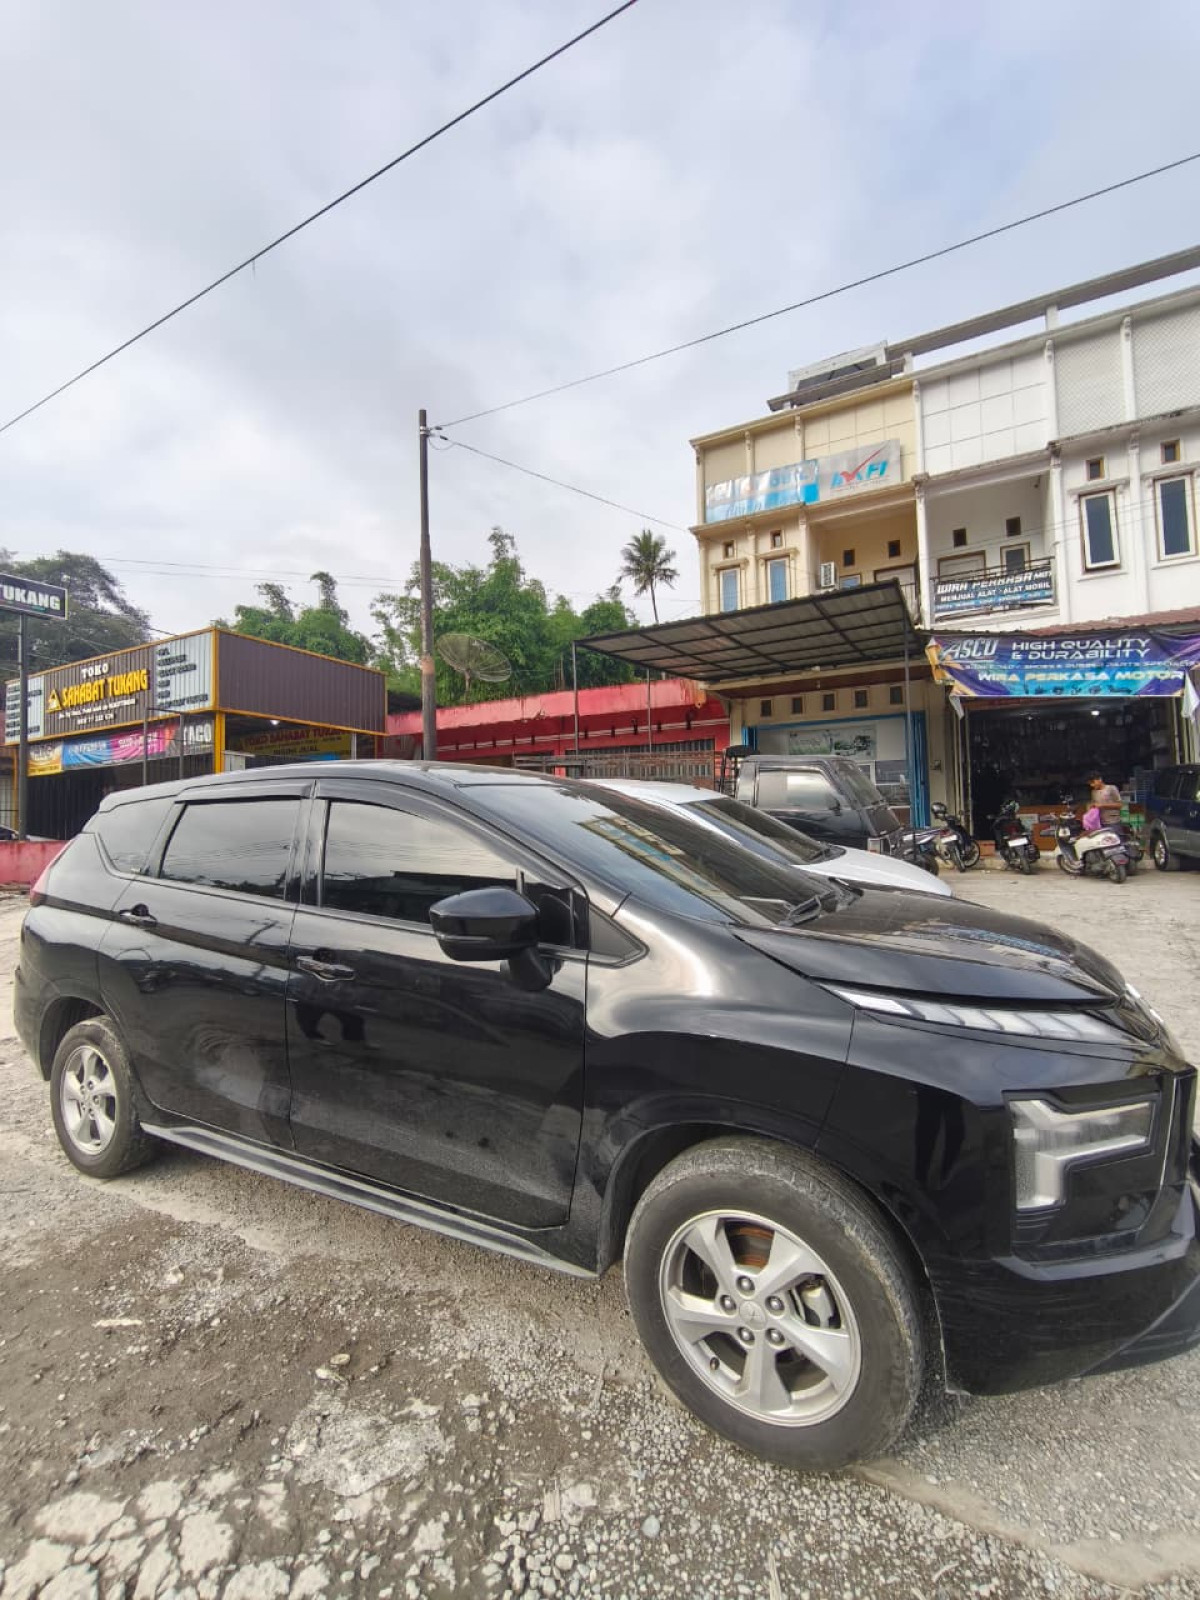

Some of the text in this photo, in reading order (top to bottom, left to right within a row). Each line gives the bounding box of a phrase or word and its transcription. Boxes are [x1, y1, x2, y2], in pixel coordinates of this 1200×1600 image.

[0, 584, 61, 611] UKANG
[977, 589, 997, 597] ALAT
[1003, 586, 1023, 595] ALAT
[1012, 640, 1056, 651] HIGH
[1060, 638, 1152, 650] QUALITY
[1027, 648, 1152, 660] DURABILITY
[81, 662, 109, 679] TOKO
[978, 670, 1185, 682] WIRA PERKASA MOTOR
[62, 679, 105, 707] SAHABAT
[107, 669, 148, 697] TUKANG
